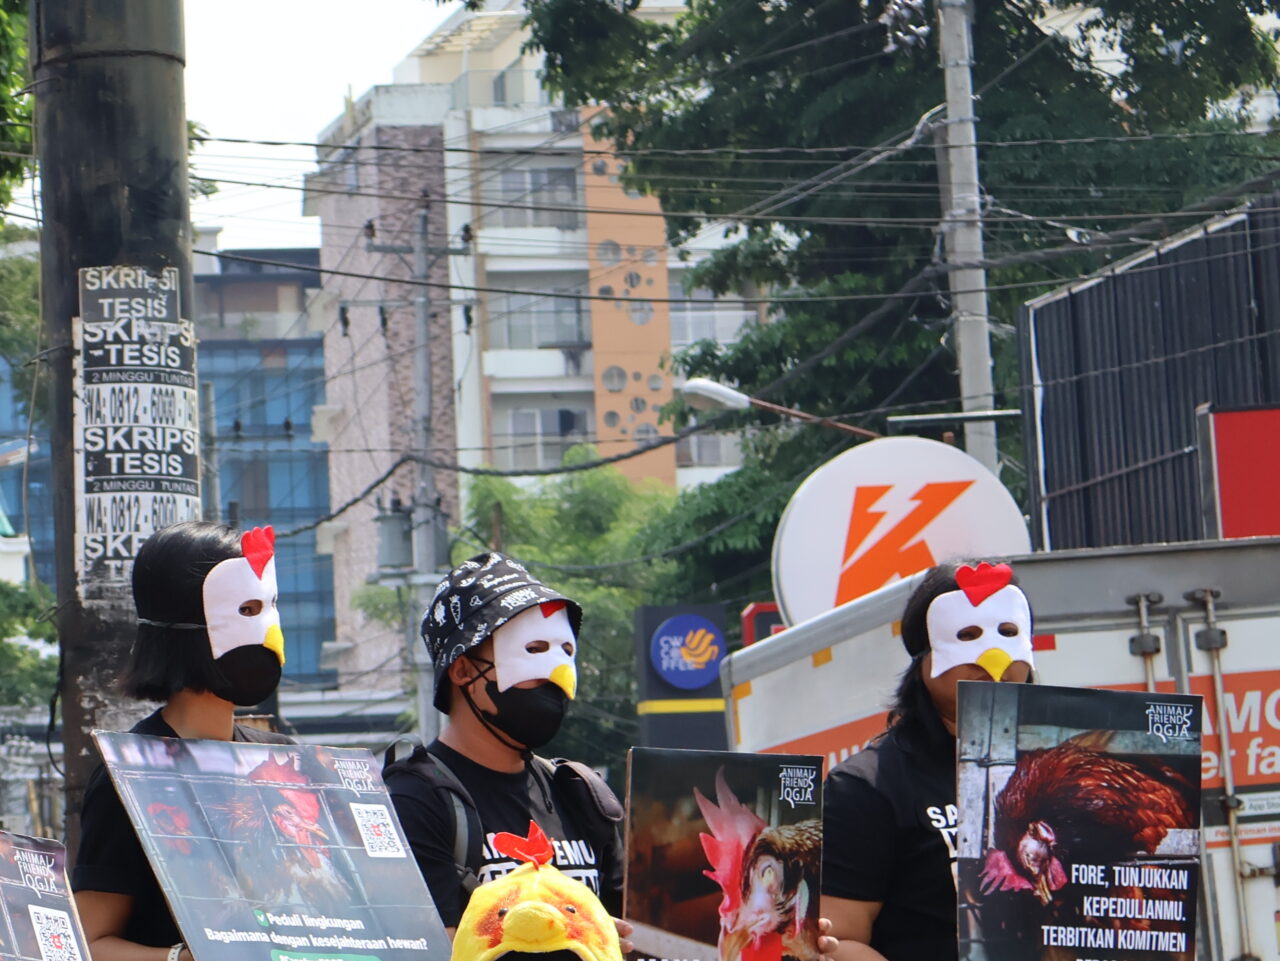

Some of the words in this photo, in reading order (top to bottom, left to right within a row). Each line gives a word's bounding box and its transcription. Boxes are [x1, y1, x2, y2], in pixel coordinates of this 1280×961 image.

[98, 297, 168, 319] TESIS
[104, 344, 181, 367] TESIS
[102, 371, 153, 382] MINGGU
[110, 386, 139, 424] 0812
[105, 453, 183, 476] TESIS
[103, 480, 155, 491] MINGGU
[160, 482, 197, 494] TUNTAS
[1145, 704, 1193, 716] ANIMAL
[1071, 864, 1109, 888] FORE,
[1112, 866, 1188, 890] TUNJUKKAN
[1083, 896, 1186, 921] KEPEDULIANMU.
[267, 912, 302, 928] Peduli
[302, 914, 365, 932] lingkungan
[204, 927, 270, 944] Bagaimana
[270, 931, 311, 948] dengan
[310, 934, 387, 951] kesejahteraan
[387, 936, 428, 951] hewan?
[1041, 925, 1115, 949] TERBITKAN
[1117, 929, 1186, 952] KOMITMEN
